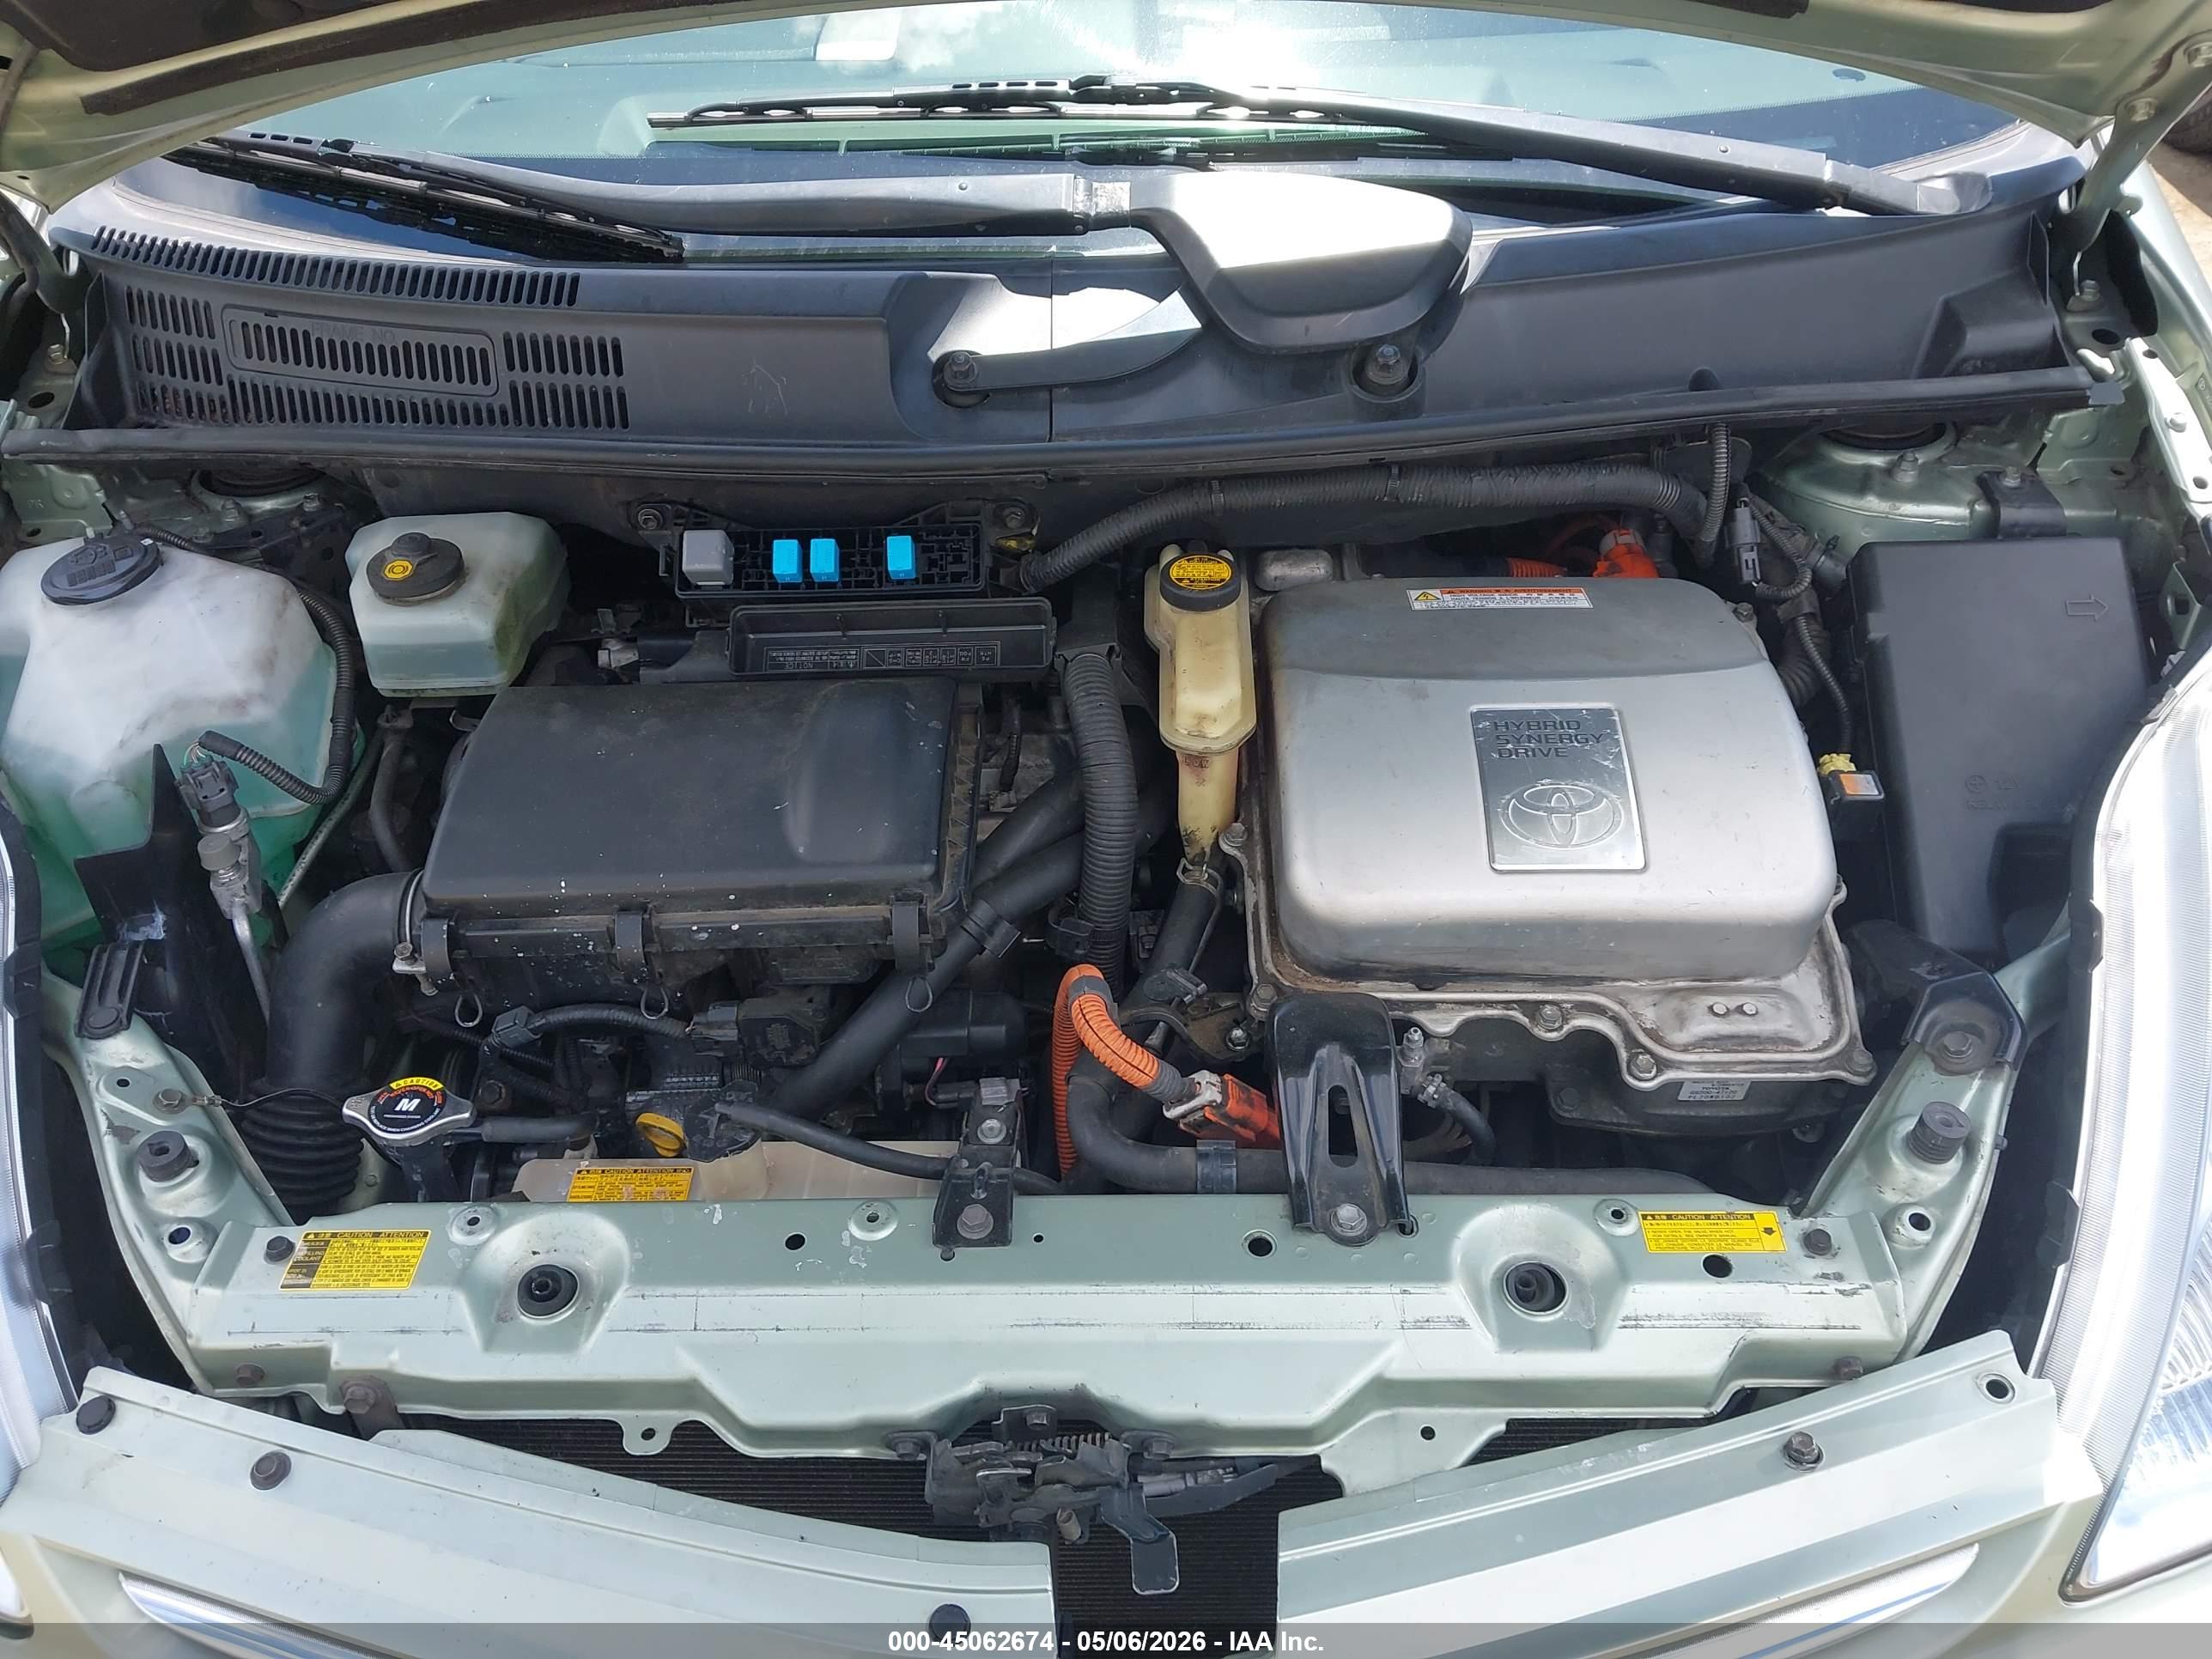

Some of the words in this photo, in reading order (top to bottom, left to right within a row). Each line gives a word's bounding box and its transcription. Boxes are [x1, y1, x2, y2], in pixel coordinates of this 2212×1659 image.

[1494, 720, 1581, 731] HYBRID
[1496, 732, 1603, 744] SYNERGY
[1498, 746, 1569, 758] DRIVE
[1184, 756, 1210, 769] LOW
[403, 1079, 439, 1088] CAUTION
[394, 1098, 422, 1112] M
